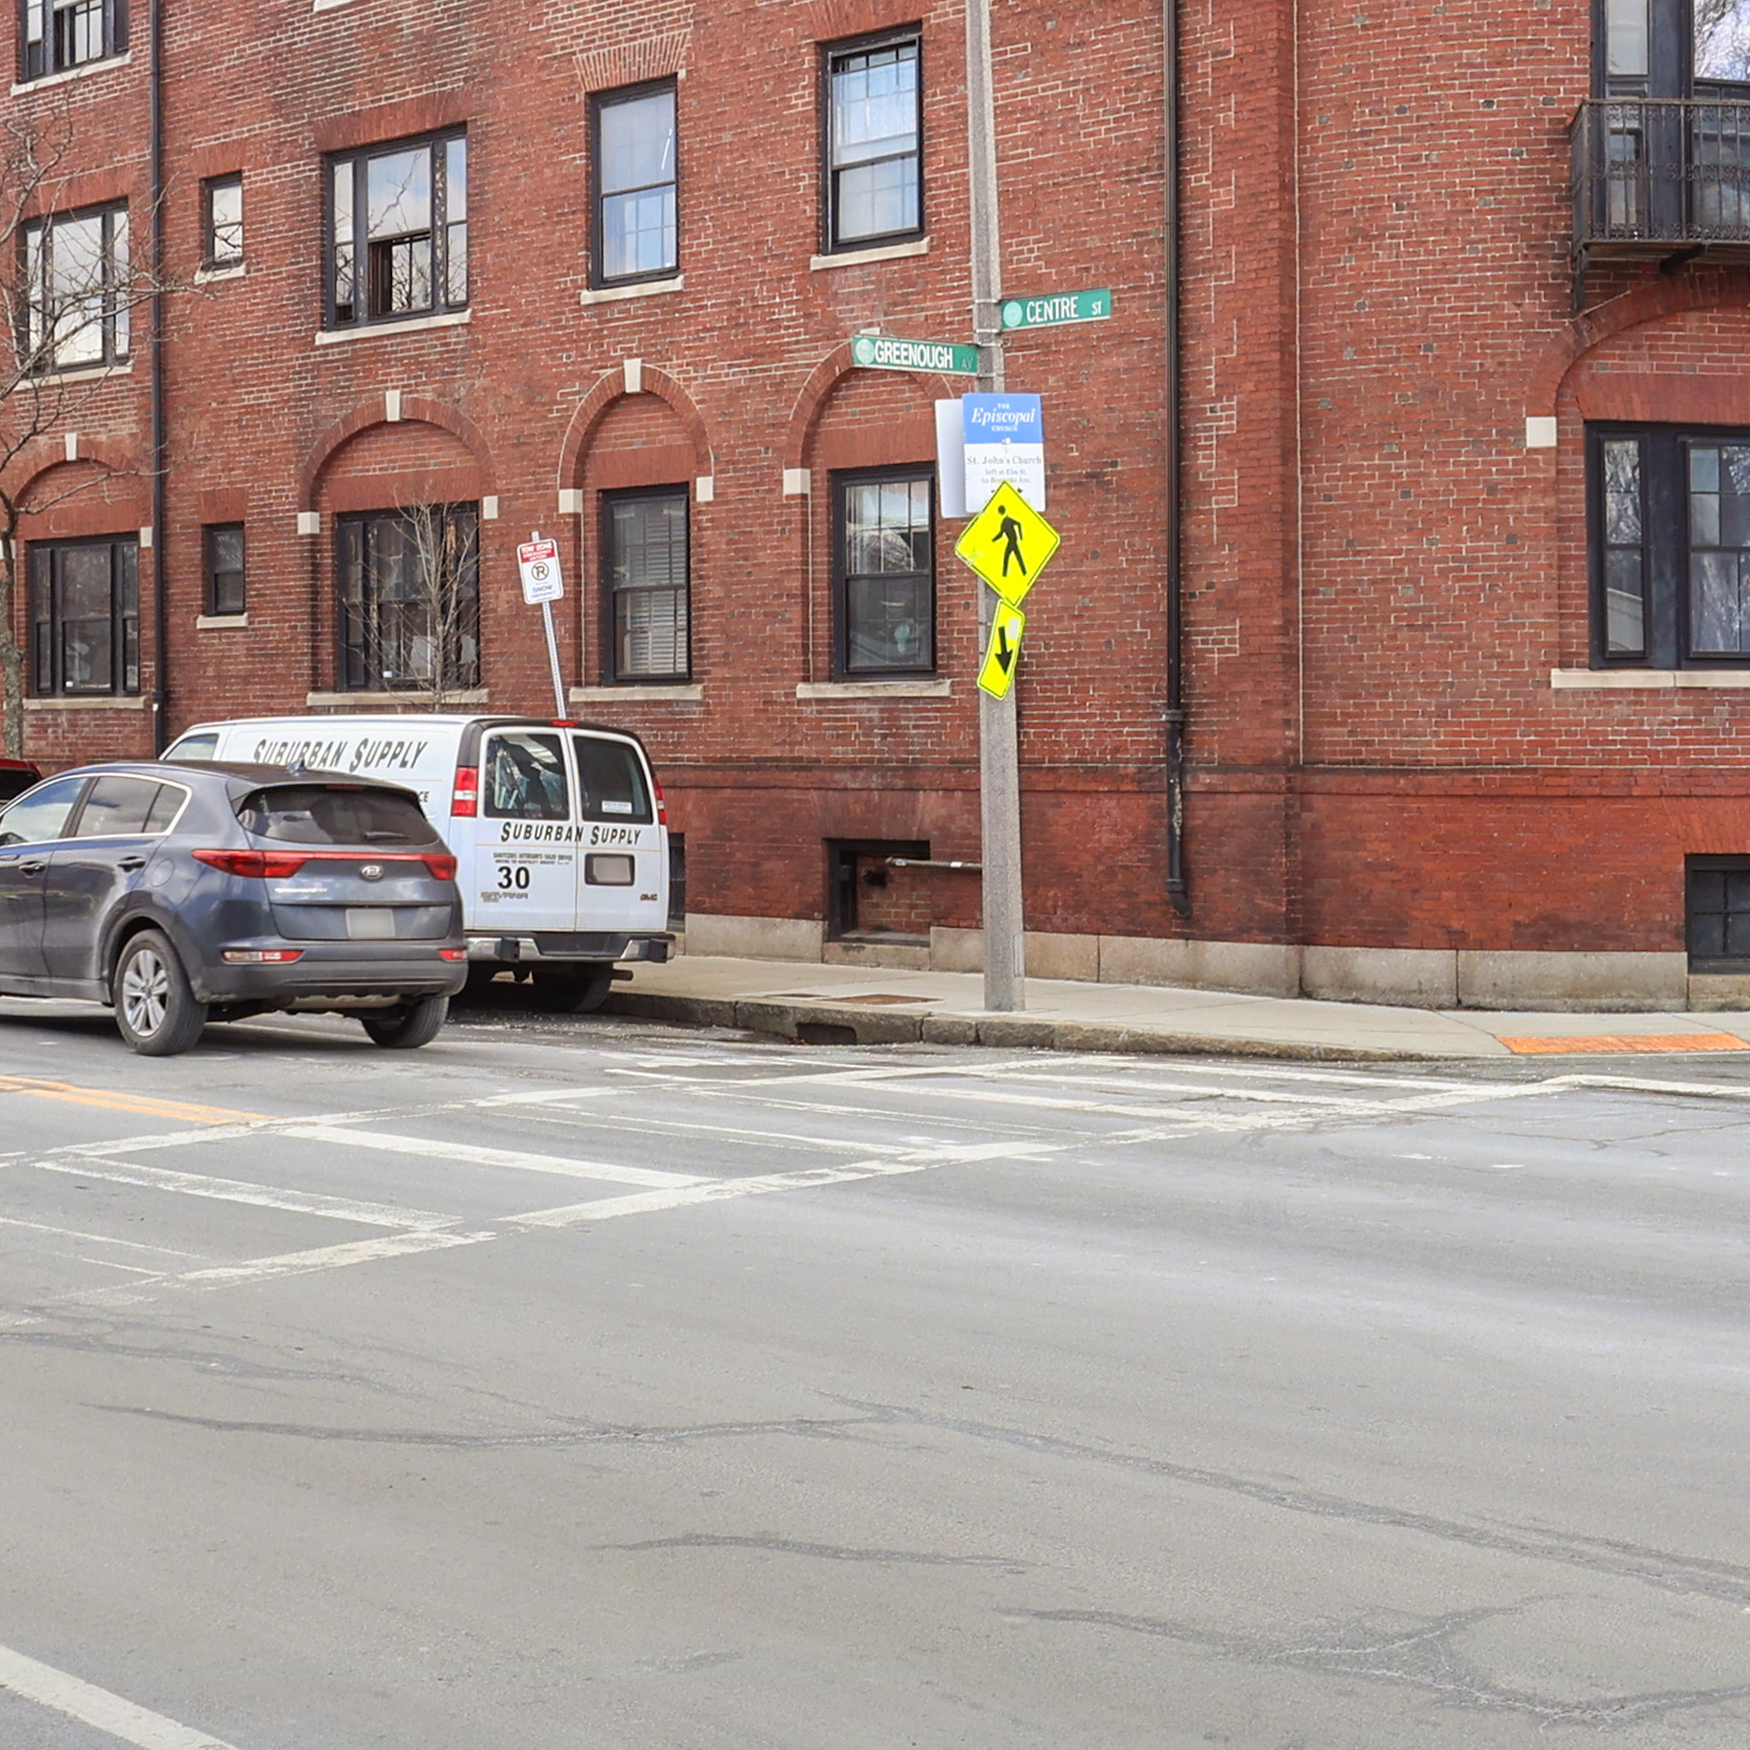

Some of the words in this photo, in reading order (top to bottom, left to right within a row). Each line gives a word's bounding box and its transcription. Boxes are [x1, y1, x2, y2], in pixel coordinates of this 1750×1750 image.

[1026, 296, 1079, 323] CENTRE
[1091, 300, 1102, 316] ST
[874, 340, 954, 370] GREENOUGH
[971, 407, 1036, 426] Episcopal
[967, 456, 980, 465] St.
[982, 456, 1010, 465] John's
[1012, 455, 1042, 464] Church
[349, 737, 428, 774] SUPPLY
[500, 821, 584, 843] SUBURBAN
[590, 825, 642, 846] SUPPLY
[497, 866, 530, 890] 30
